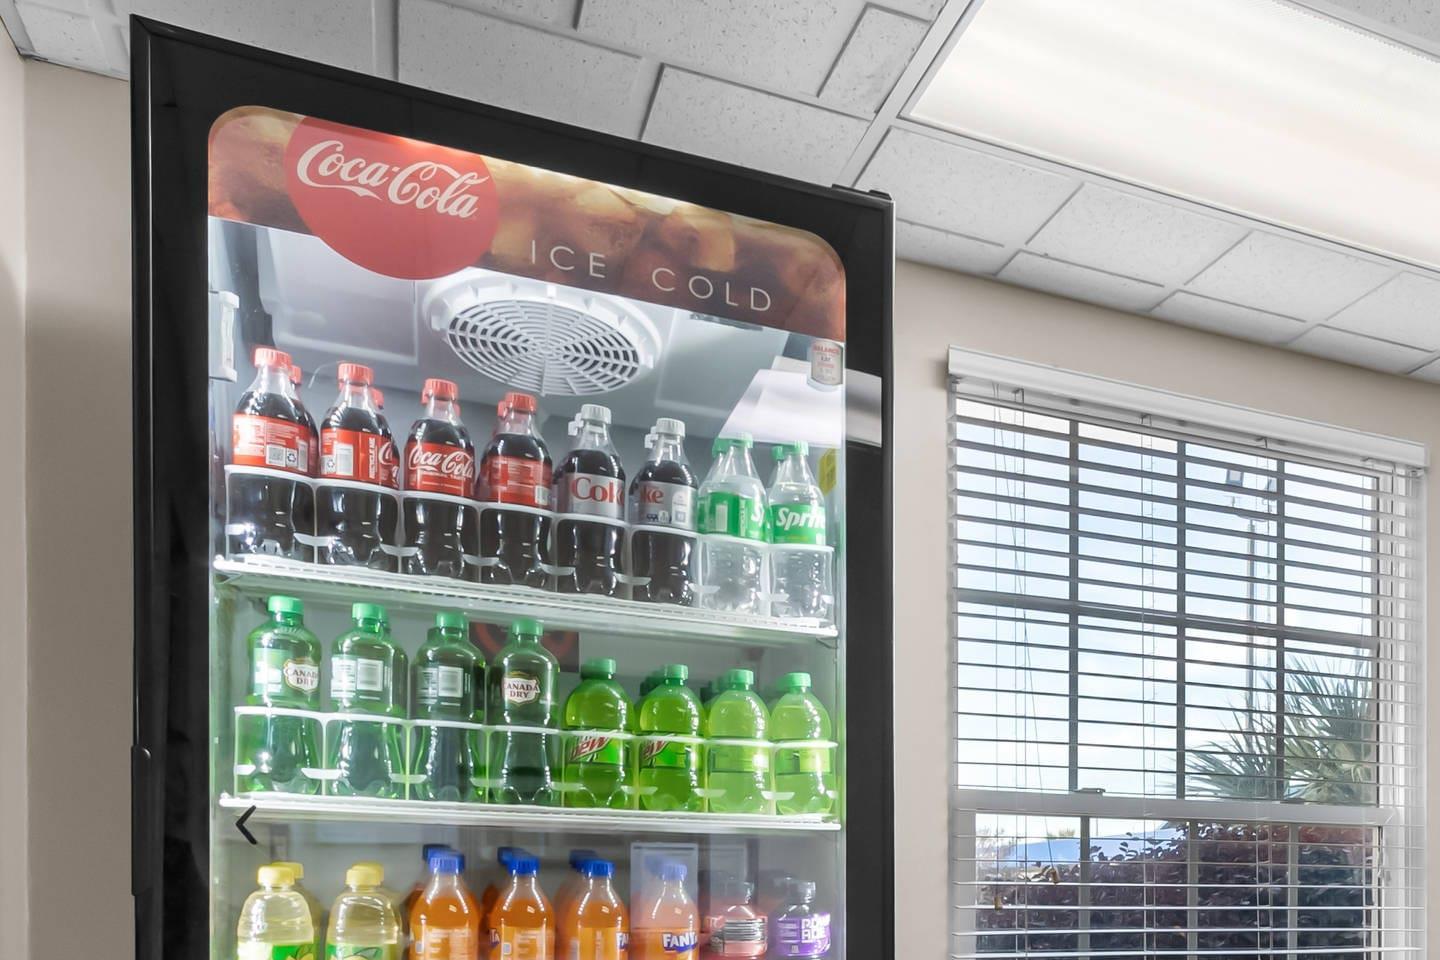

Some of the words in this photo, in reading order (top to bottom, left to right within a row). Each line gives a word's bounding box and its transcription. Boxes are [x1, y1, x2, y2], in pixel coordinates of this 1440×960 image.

[297, 140, 490, 218] Coca-Cola
[531, 239, 606, 278] ICE
[651, 267, 772, 312] COLD
[509, 690, 530, 699] DRY
